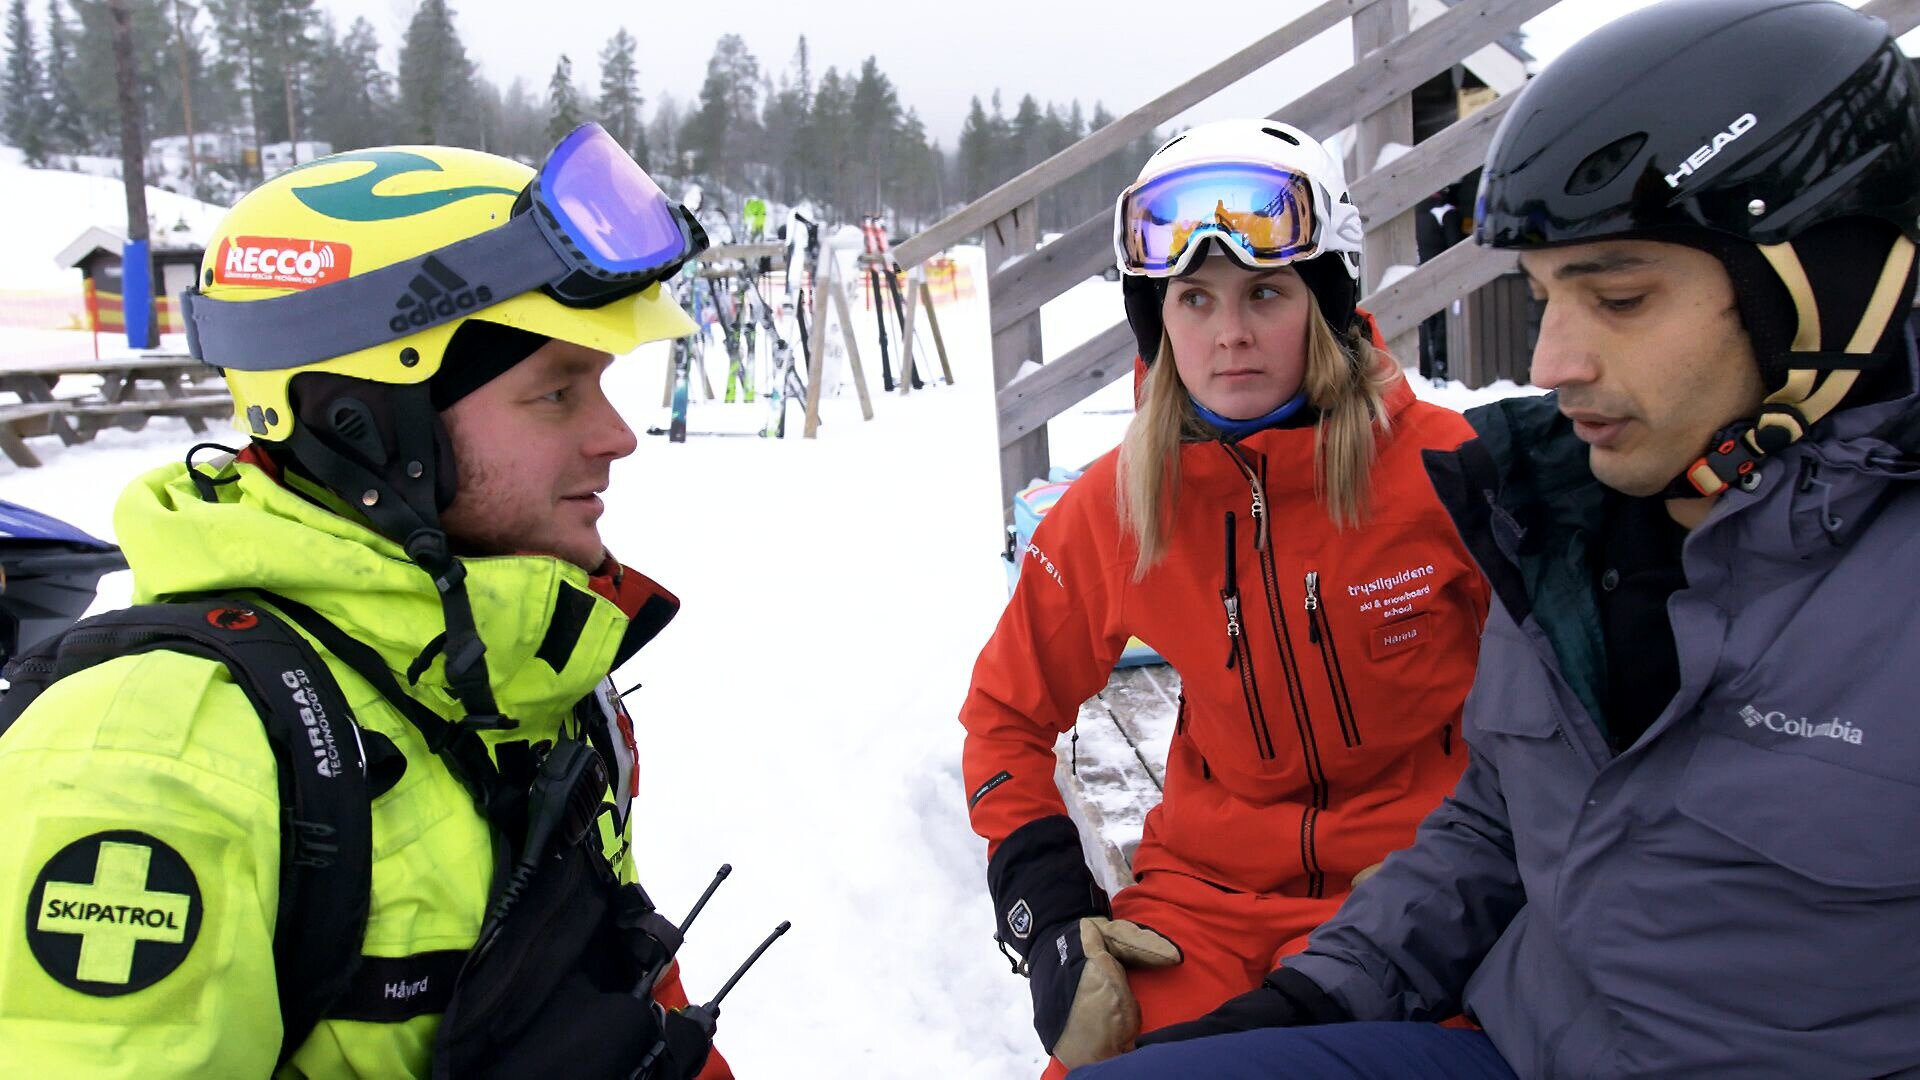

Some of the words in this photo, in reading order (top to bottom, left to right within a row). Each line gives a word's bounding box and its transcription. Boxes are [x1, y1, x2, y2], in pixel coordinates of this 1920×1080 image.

[1664, 113, 1758, 188] HEAD
[224, 246, 321, 277] RECCO
[389, 285, 493, 333] adidas
[1025, 543, 1064, 588] RYSIL
[281, 671, 332, 777] AIRBAG
[304, 686, 342, 777] TECHNOLOGY
[1764, 711, 1863, 744] Columbia
[46, 899, 179, 930] SKIPATROL
